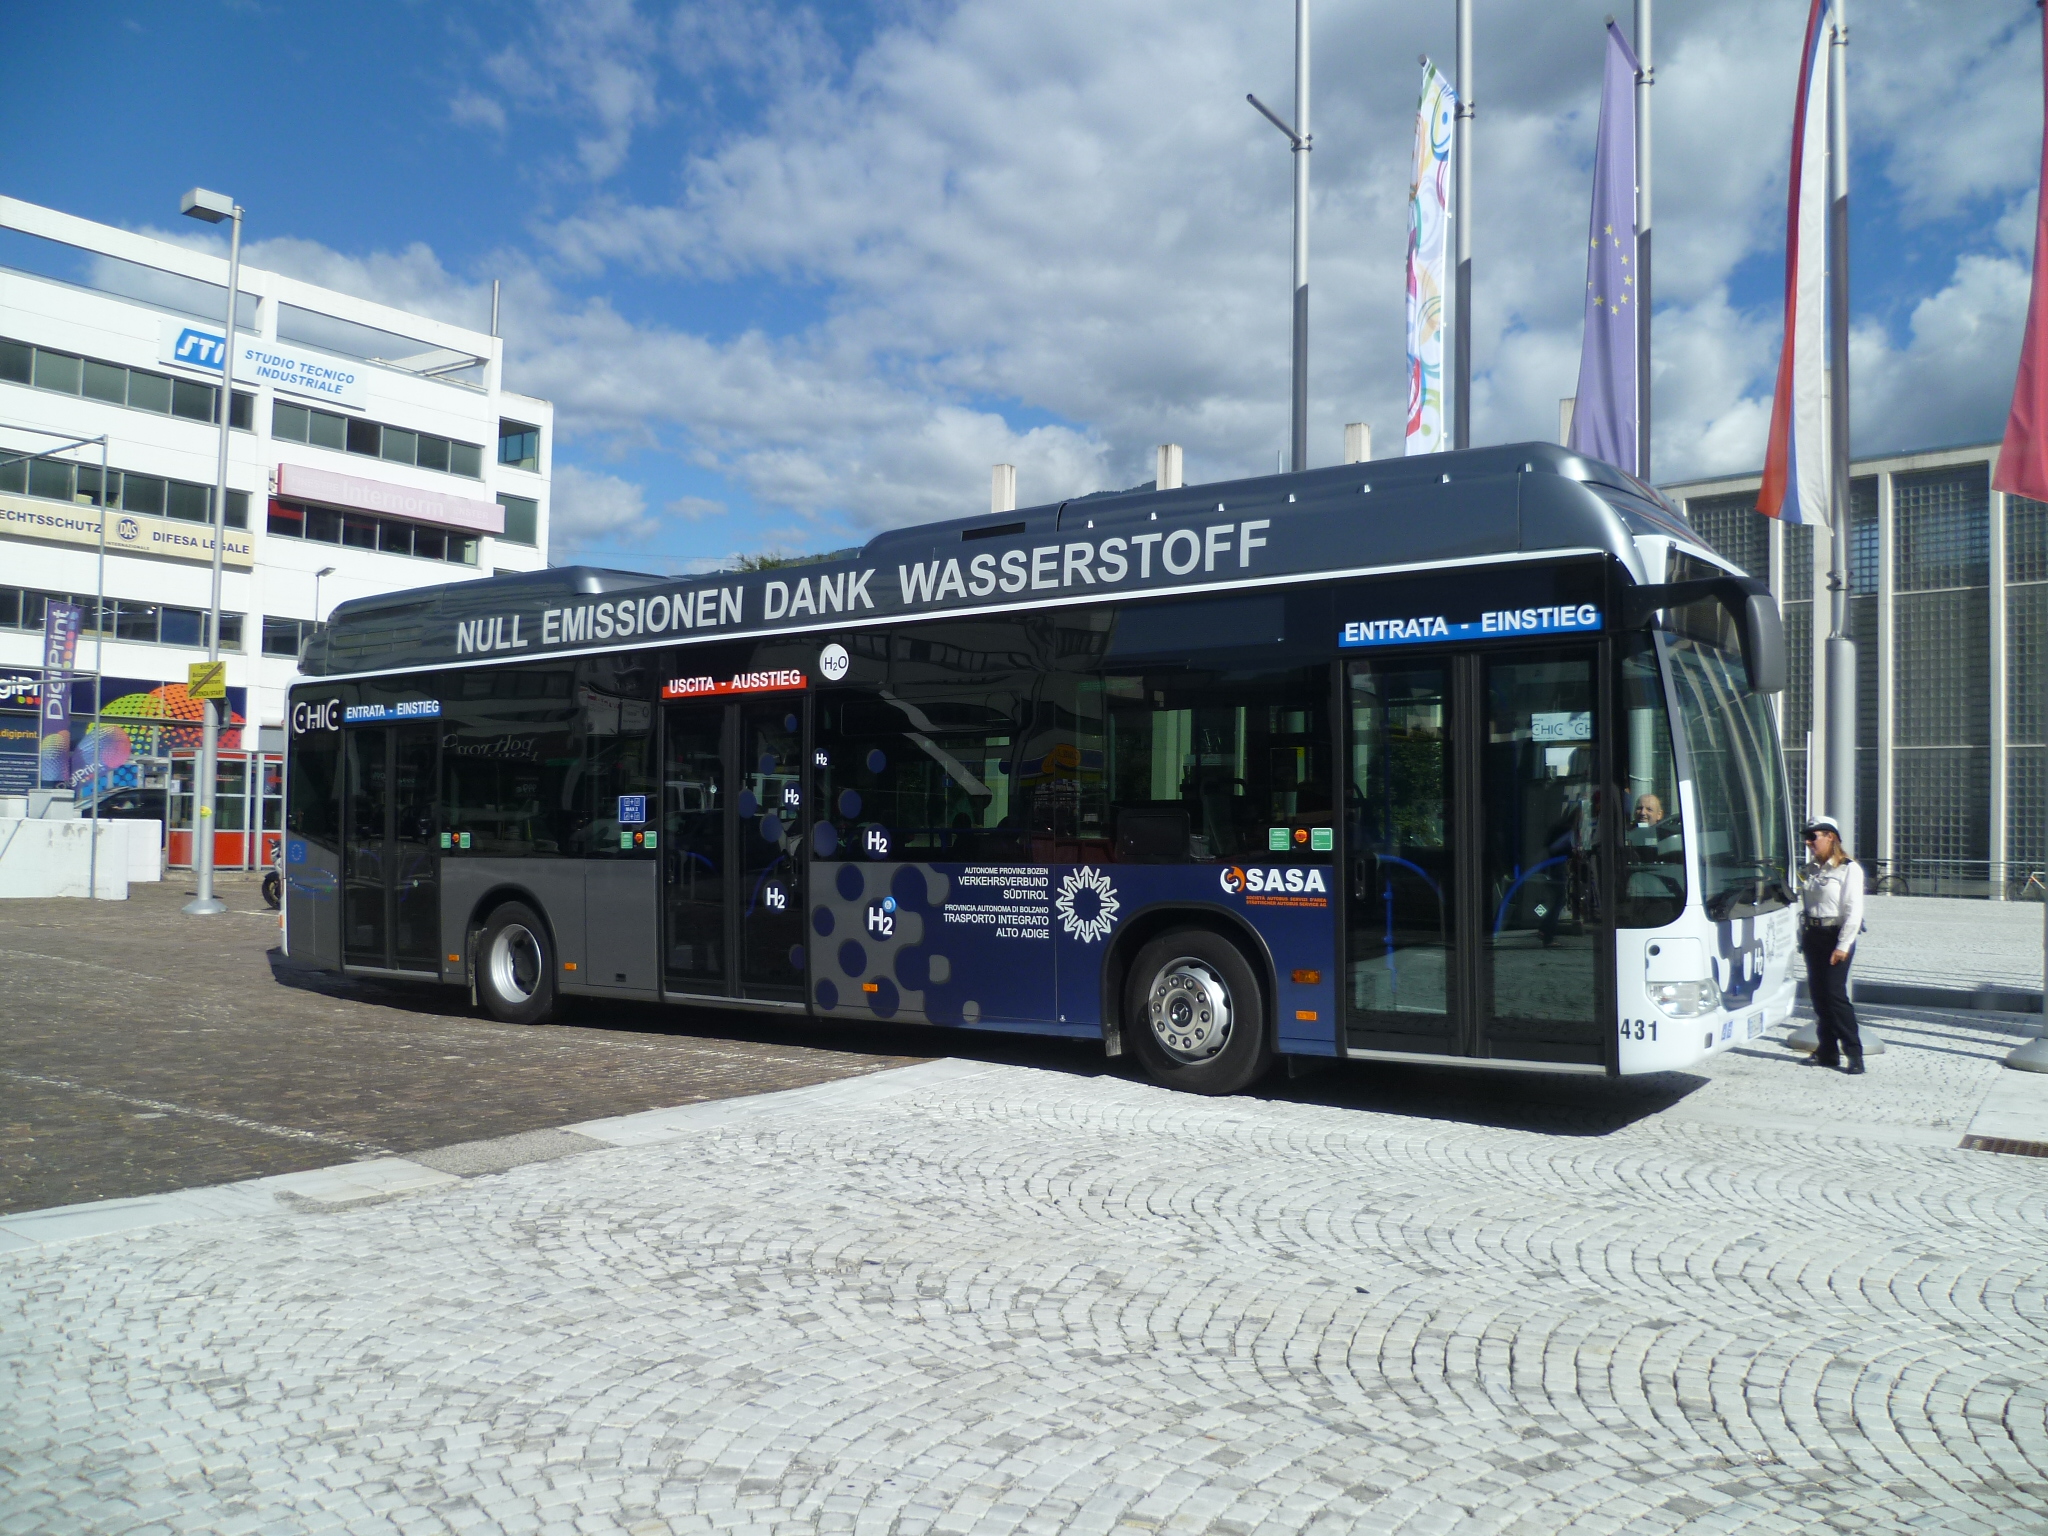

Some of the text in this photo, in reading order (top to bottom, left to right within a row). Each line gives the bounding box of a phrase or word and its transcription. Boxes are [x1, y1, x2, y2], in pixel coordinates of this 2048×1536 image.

[245, 349, 355, 384] STUDIO TECNICO
[256, 366, 343, 394] INDUSTRIALE
[343, 479, 444, 517] Internorm
[153, 531, 198, 547] DIFESA
[457, 519, 1270, 654] NULL EMISSIONEN DANK WASSERSTOFF
[1344, 616, 1449, 642] ENTRATA
[1481, 604, 1596, 633] EINSTIEG
[46, 609, 70, 720] DigiPrint
[669, 676, 715, 694] USCITA
[731, 669, 801, 690] AUSSTIEG
[346, 704, 386, 719] ENTRATA
[396, 700, 440, 716] EINSTIEG
[867, 831, 888, 853] H2
[958, 876, 1049, 887] VERKEHRSVERBUND
[964, 867, 1049, 875] AUTONOME PROVINZ BOZEN
[1245, 868, 1326, 893] SASA
[766, 886, 785, 909] H2
[1003, 888, 1049, 900] SÜDTIROL
[943, 913, 1049, 926] TRASPORTO INTEGRATO
[944, 904, 1049, 914] PROVINCIA AUTONOMA DI BOLZANO
[868, 907, 893, 935] H2
[996, 927, 1050, 939] ALTO ADIGE
[1620, 1018, 1658, 1042] 431
